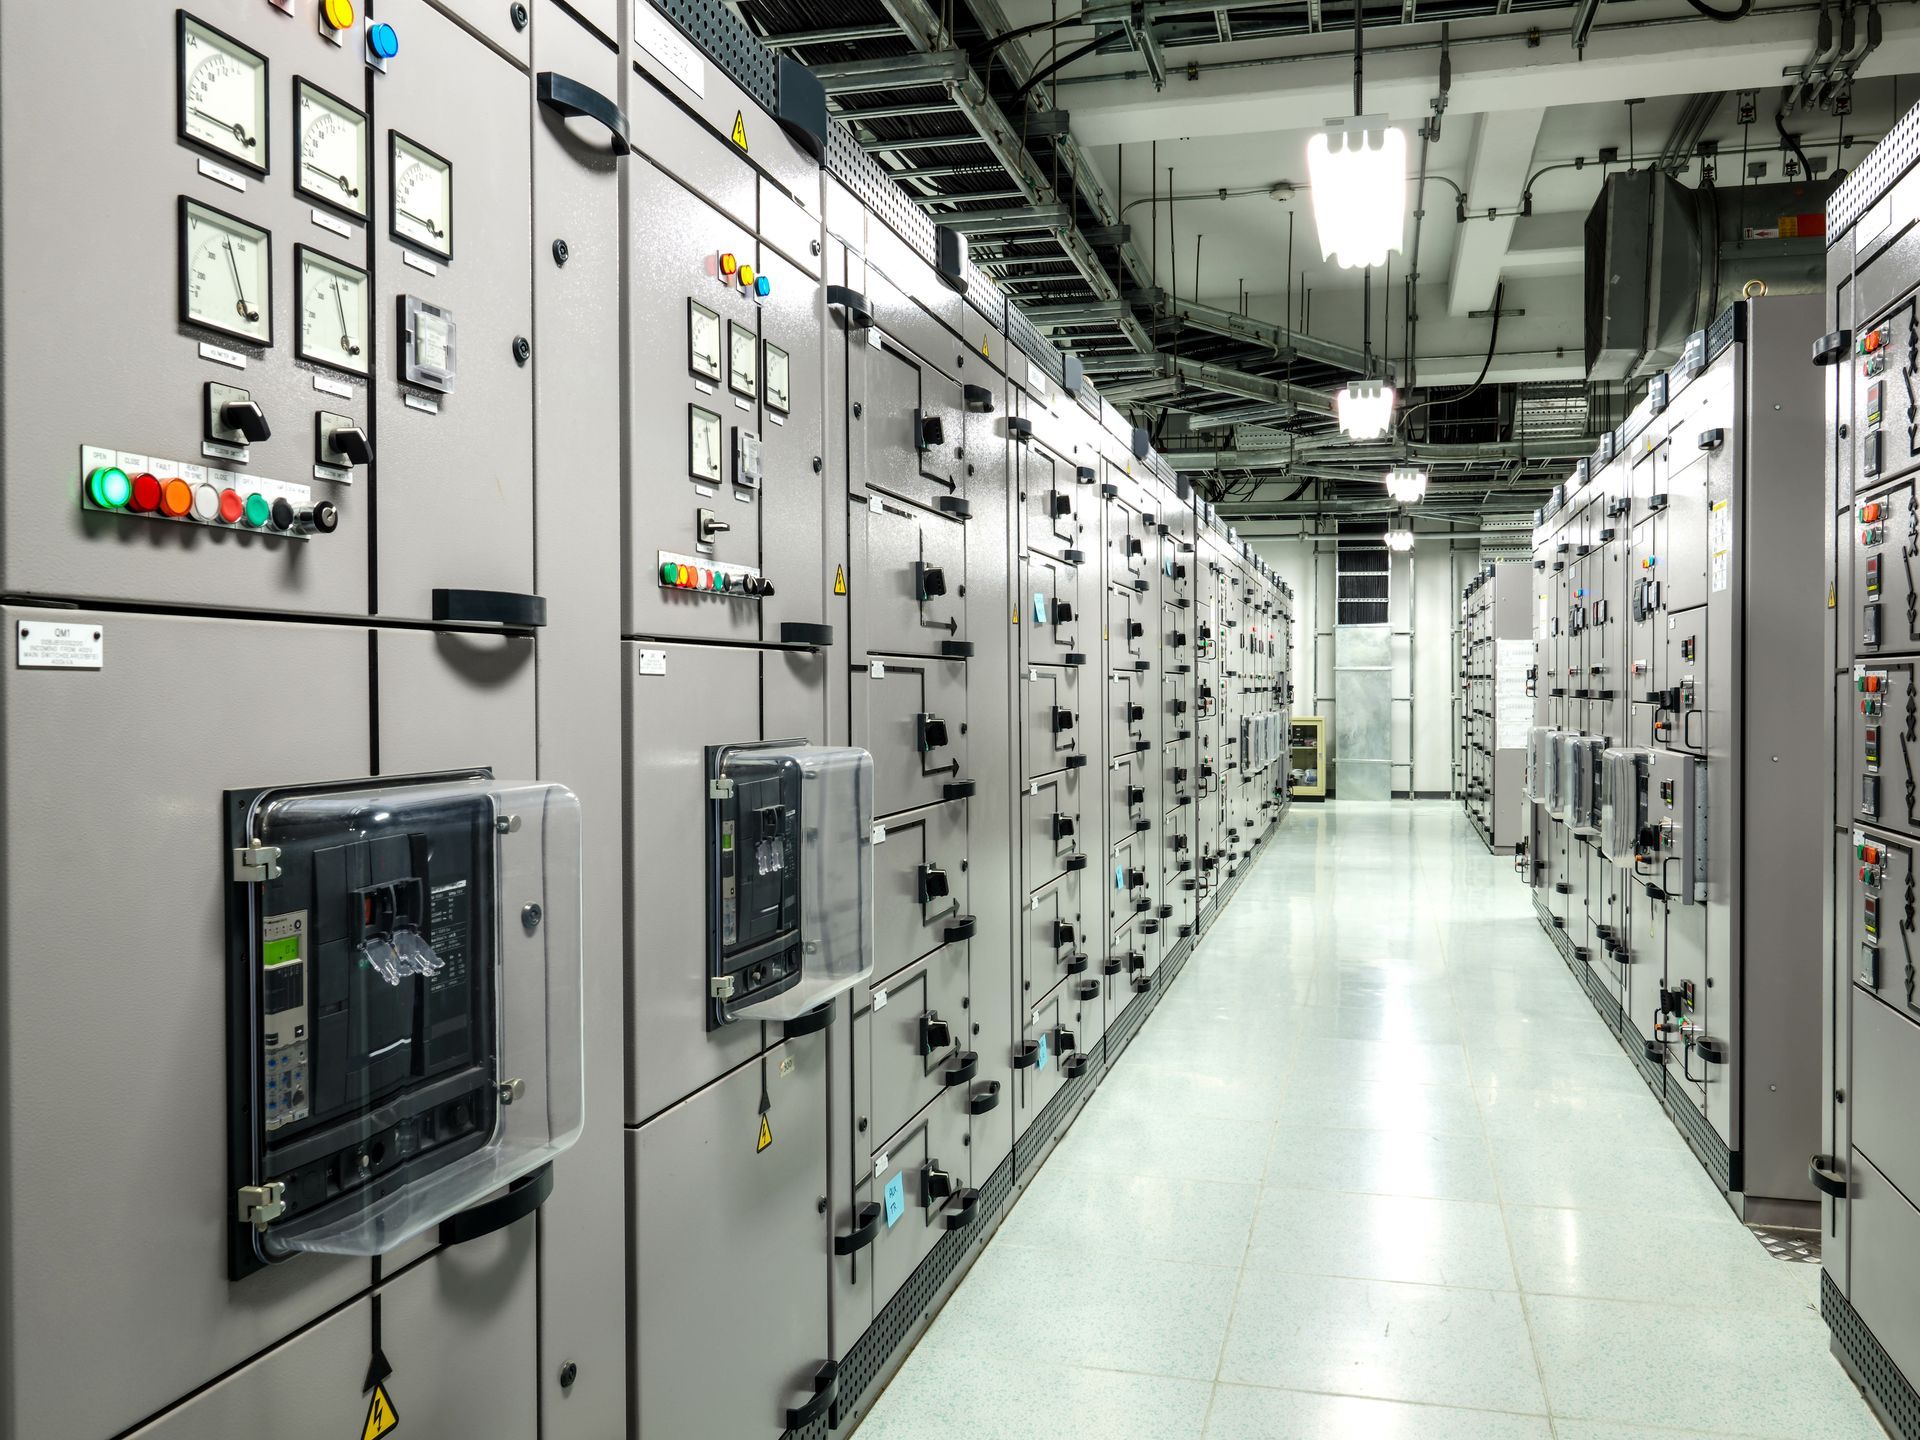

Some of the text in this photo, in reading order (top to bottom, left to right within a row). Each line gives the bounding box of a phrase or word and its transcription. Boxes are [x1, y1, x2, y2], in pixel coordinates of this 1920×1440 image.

[190, 216, 198, 230] V
[303, 262, 310, 274] V
[93, 451, 107, 460] OPEN
[124, 457, 140, 466] CLOSE
[155, 462, 171, 471] FAULT
[214, 473, 229, 482] CLOSE
